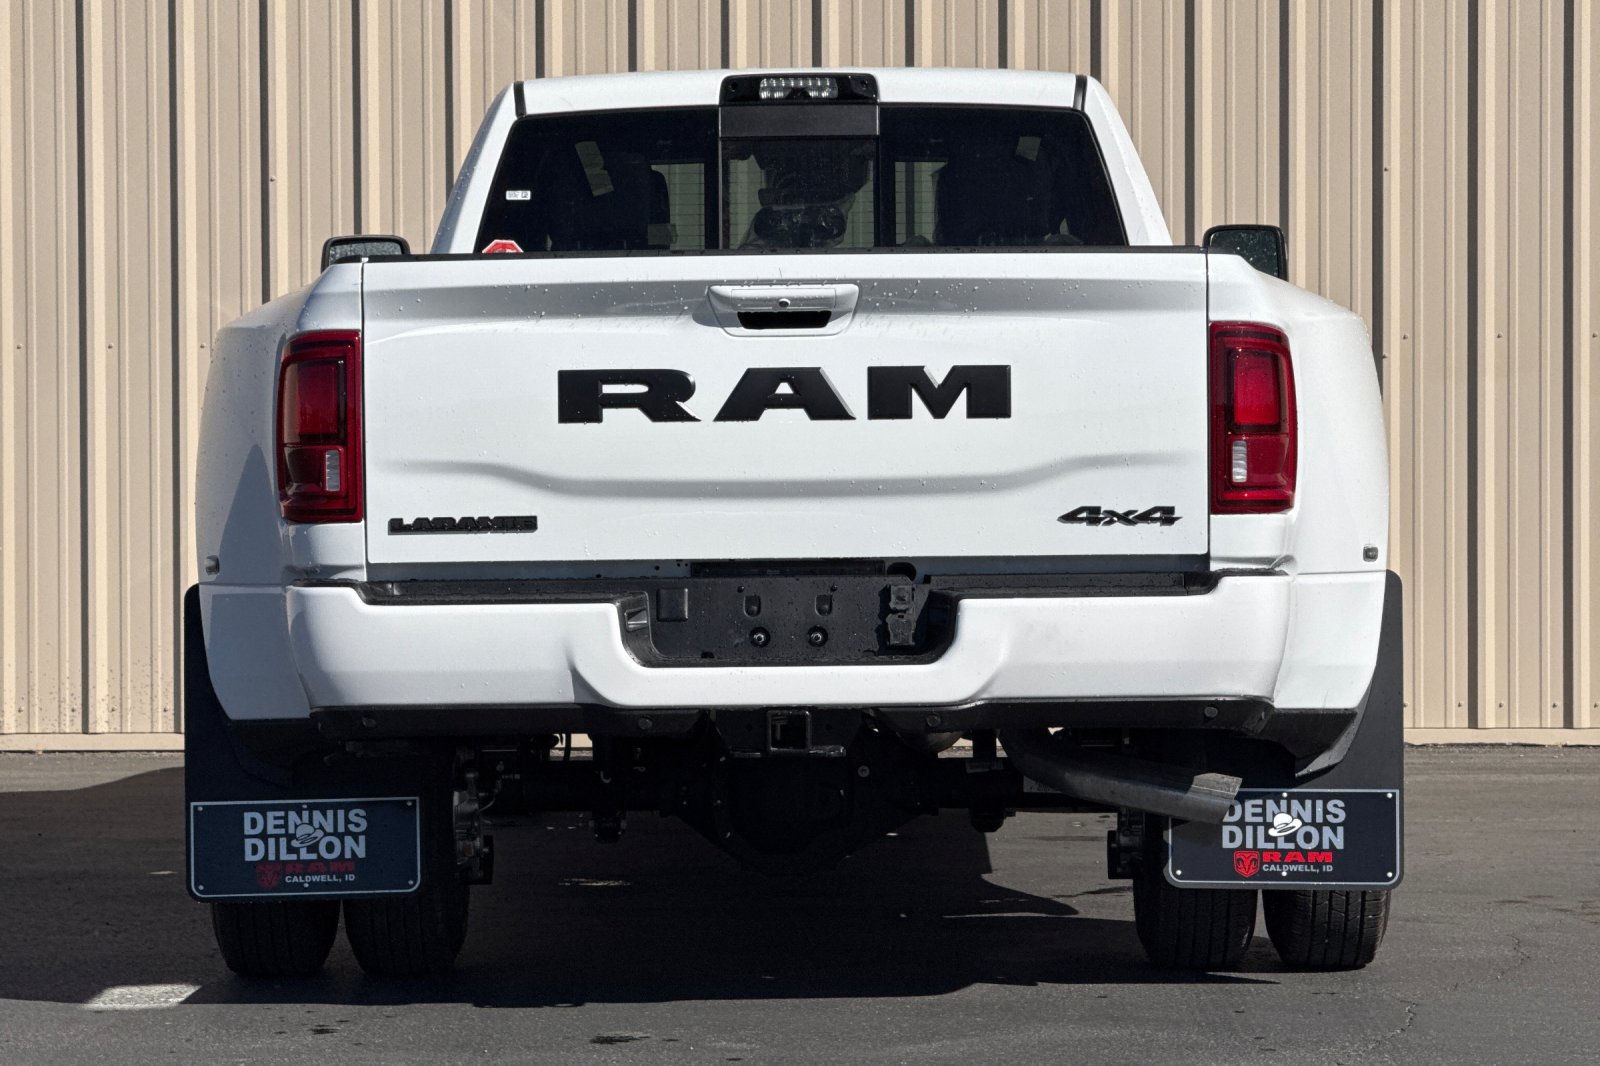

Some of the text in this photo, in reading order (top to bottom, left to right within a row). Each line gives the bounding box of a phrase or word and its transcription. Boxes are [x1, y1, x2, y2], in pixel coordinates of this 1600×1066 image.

[558, 365, 1011, 423] RAM
[388, 515, 538, 535] LARAMIE
[243, 808, 368, 835] DENNIS
[1222, 799, 1347, 823] DENNIS
[244, 835, 366, 861] DILLON
[1222, 825, 1345, 849] DILLON
[1262, 851, 1333, 863] RAM
[1262, 863, 1334, 873] CALDWELL, ID
[285, 873, 356, 883] CALDWELL, ID
